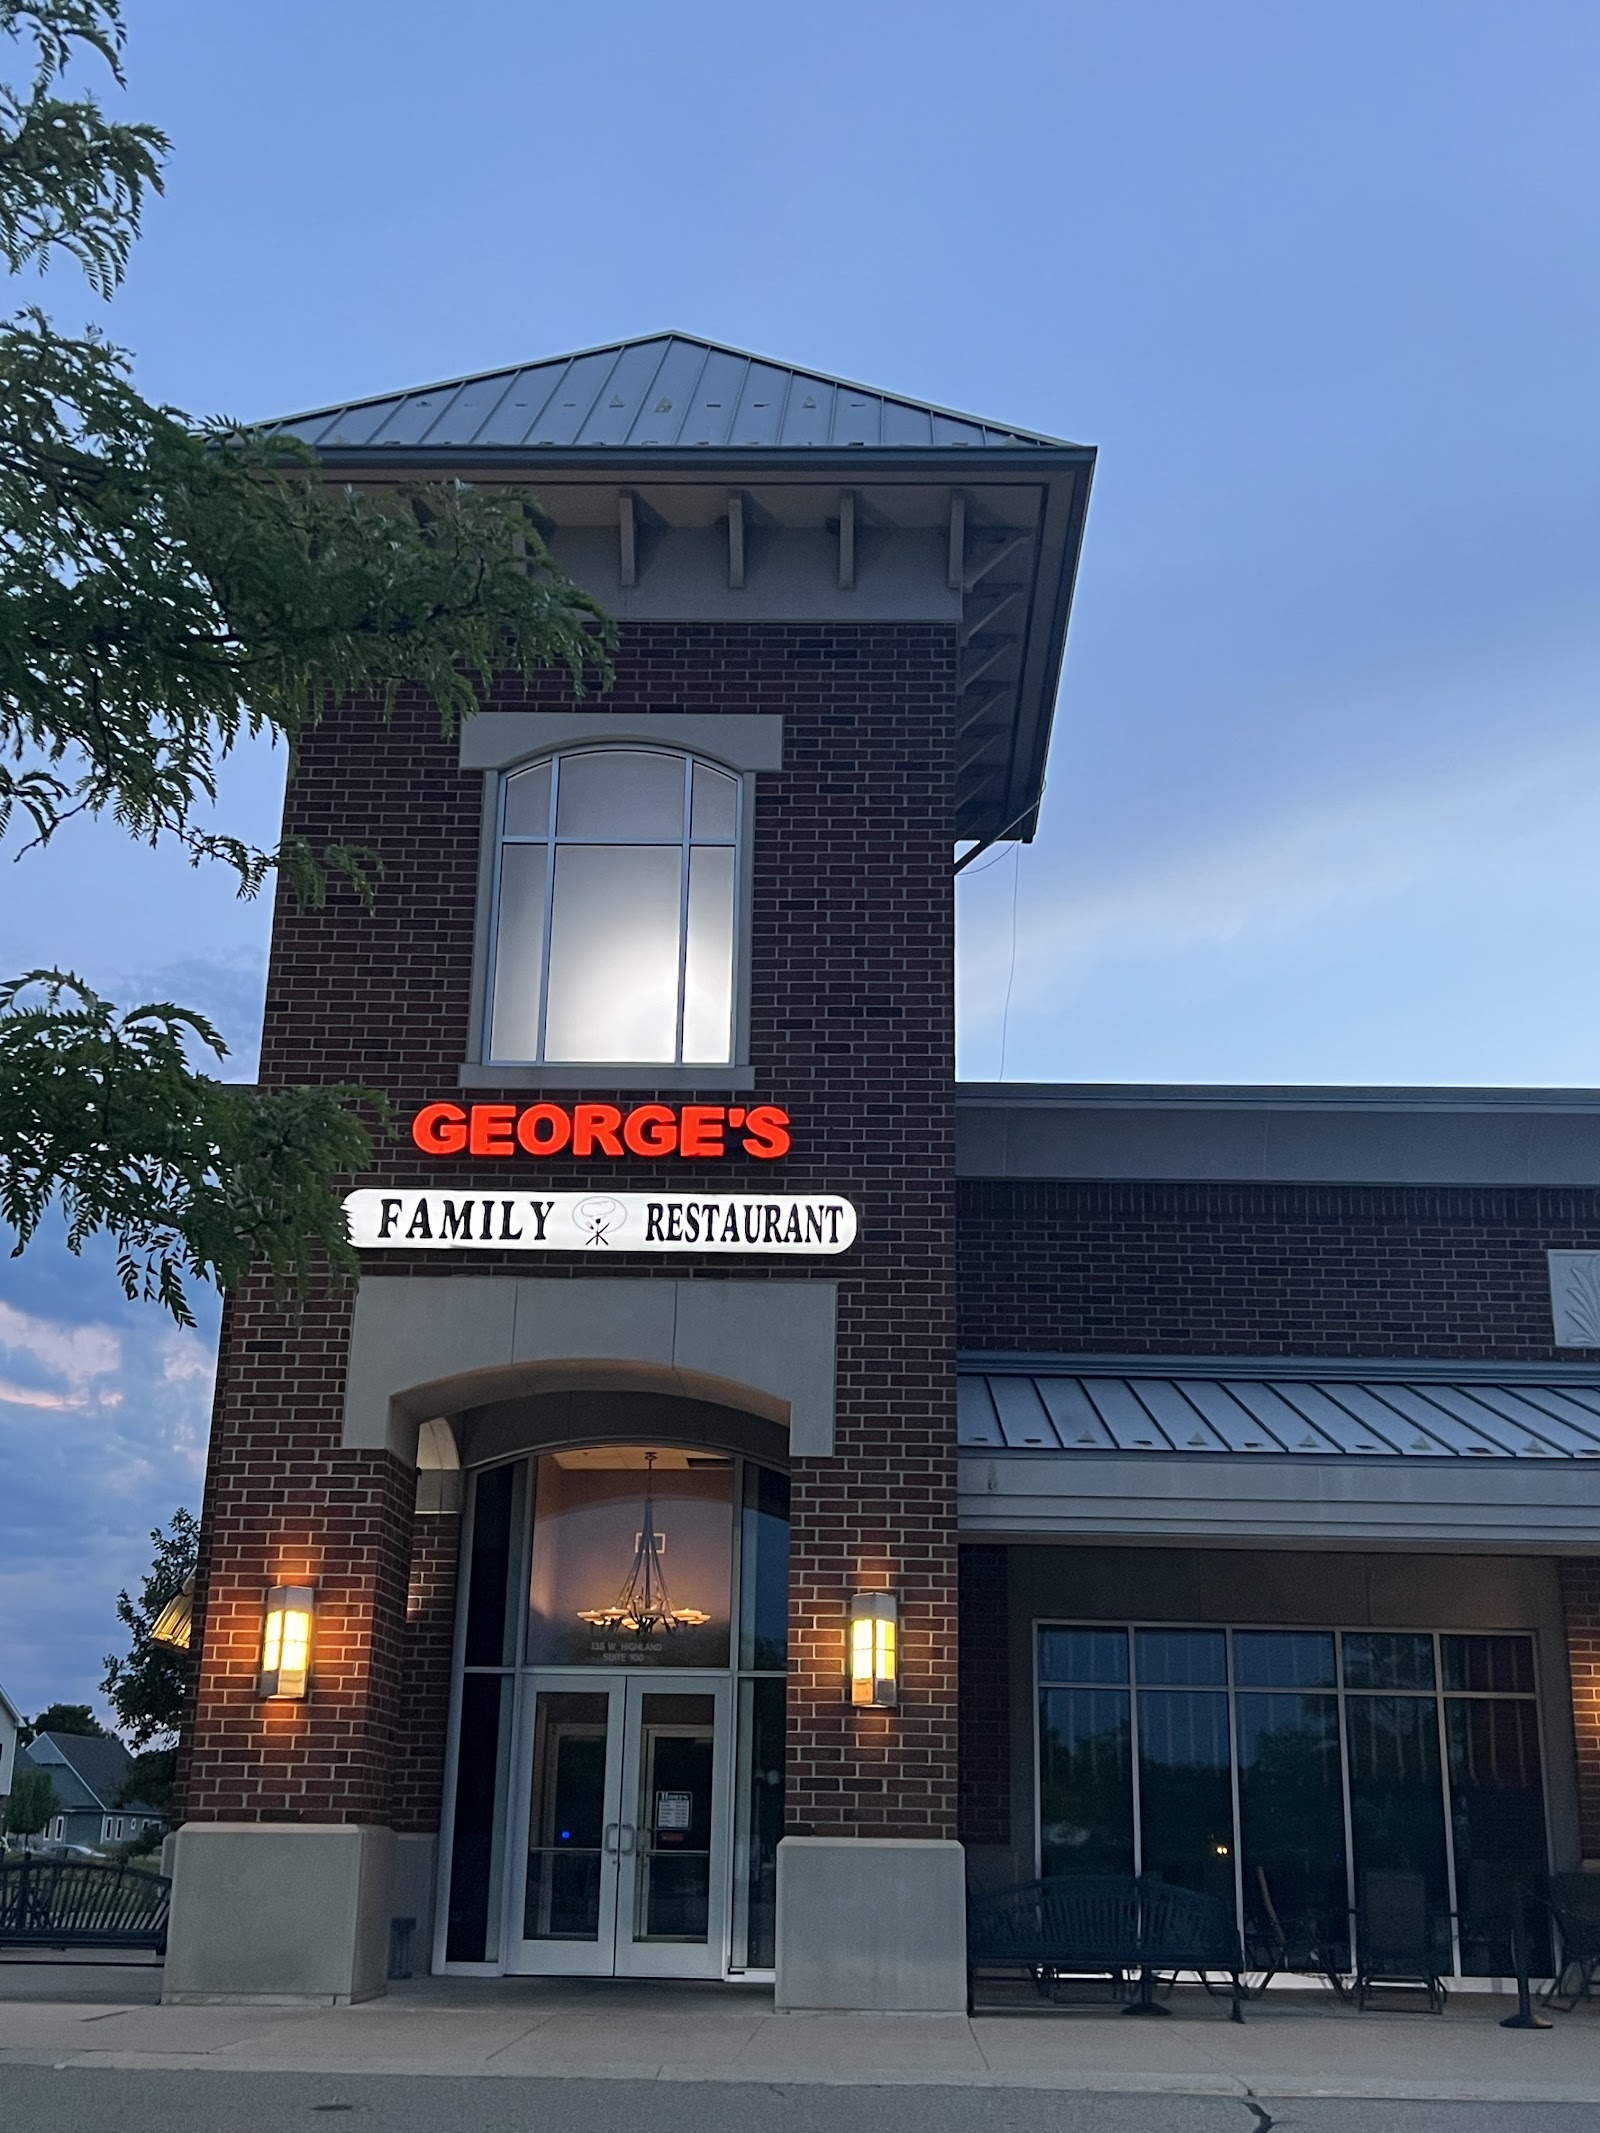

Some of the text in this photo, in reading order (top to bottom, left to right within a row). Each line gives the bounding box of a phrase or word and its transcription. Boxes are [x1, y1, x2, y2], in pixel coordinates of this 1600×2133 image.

[411, 1103, 791, 1158] GEORGE'S
[377, 1198, 844, 1244] FAMILY RESTAURANT
[603, 1653, 626, 1662] SUITE
[621, 1642, 662, 1651] HIGHLAND
